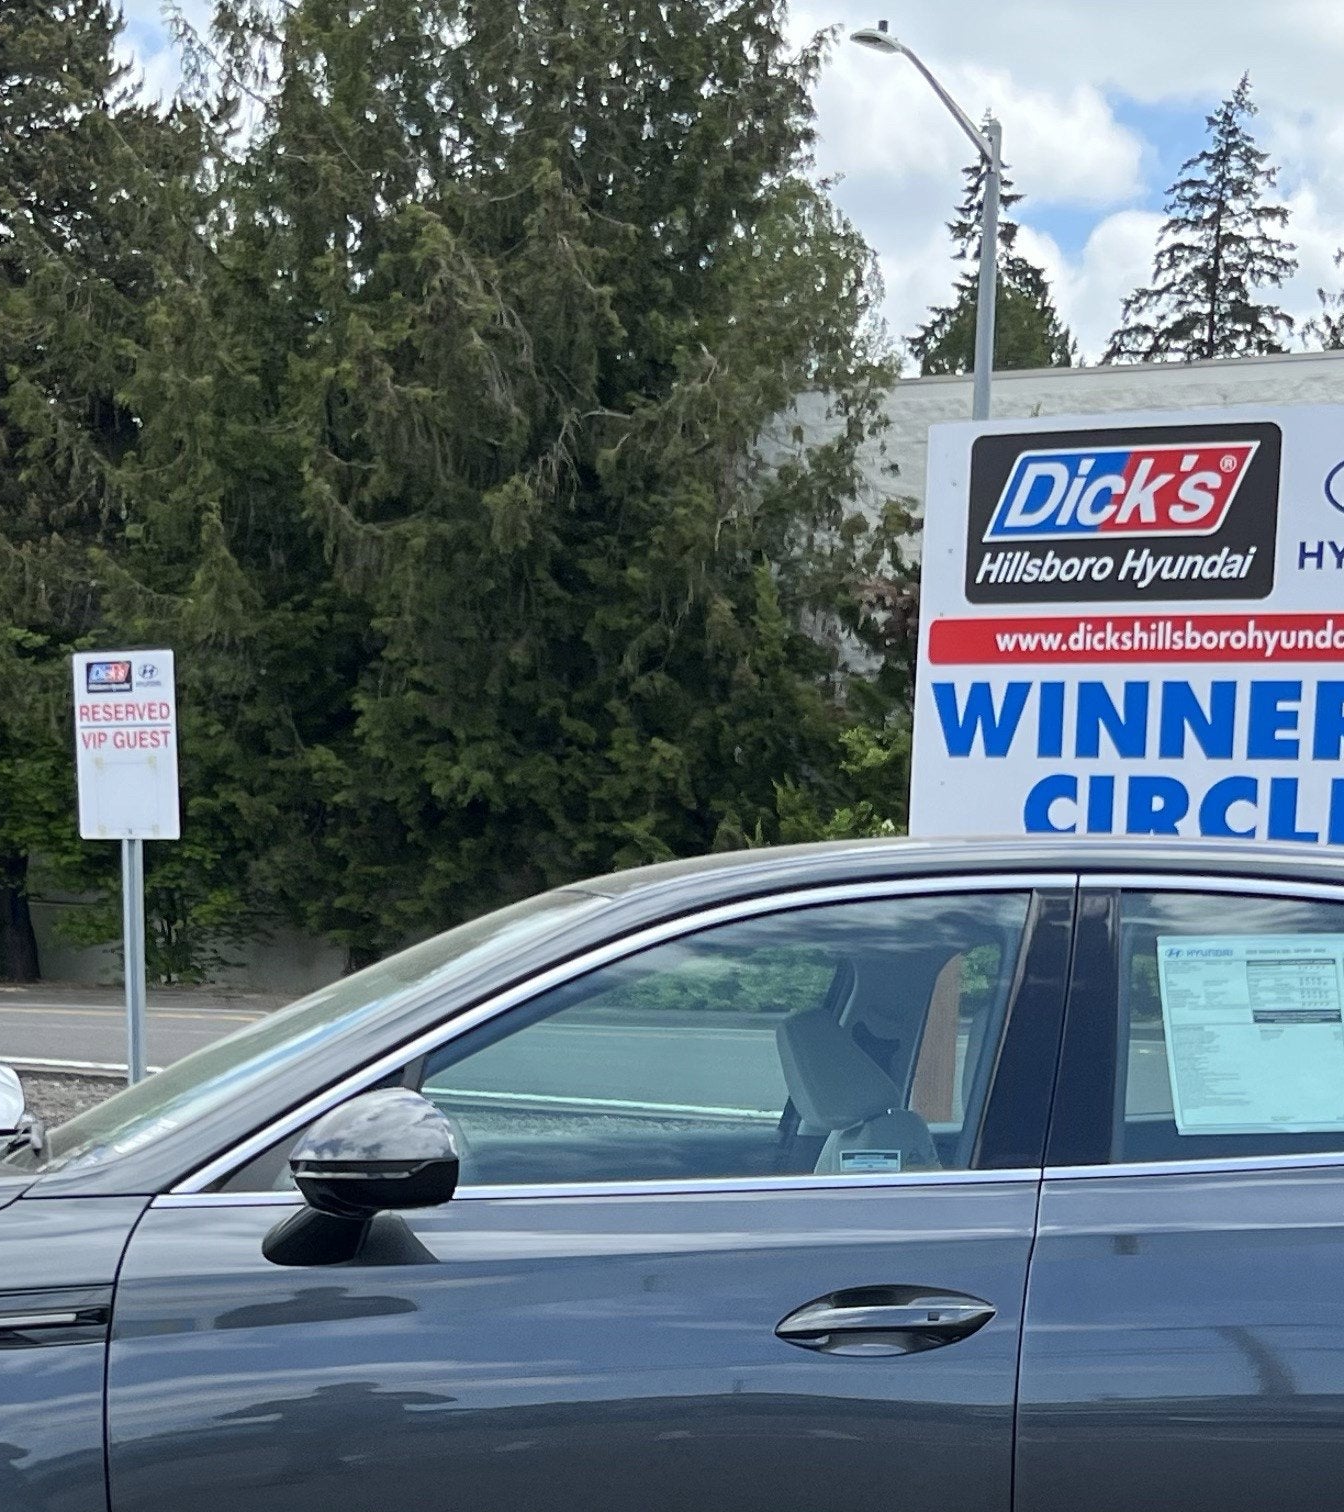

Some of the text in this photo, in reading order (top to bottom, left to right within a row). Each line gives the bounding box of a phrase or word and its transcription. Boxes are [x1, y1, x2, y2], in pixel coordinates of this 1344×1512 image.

[1004, 455, 1222, 529] Dick's
[975, 546, 1258, 589] Hillsboro Hyundai
[79, 702, 170, 722] RESERVED
[81, 730, 171, 749] VIP GUEST
